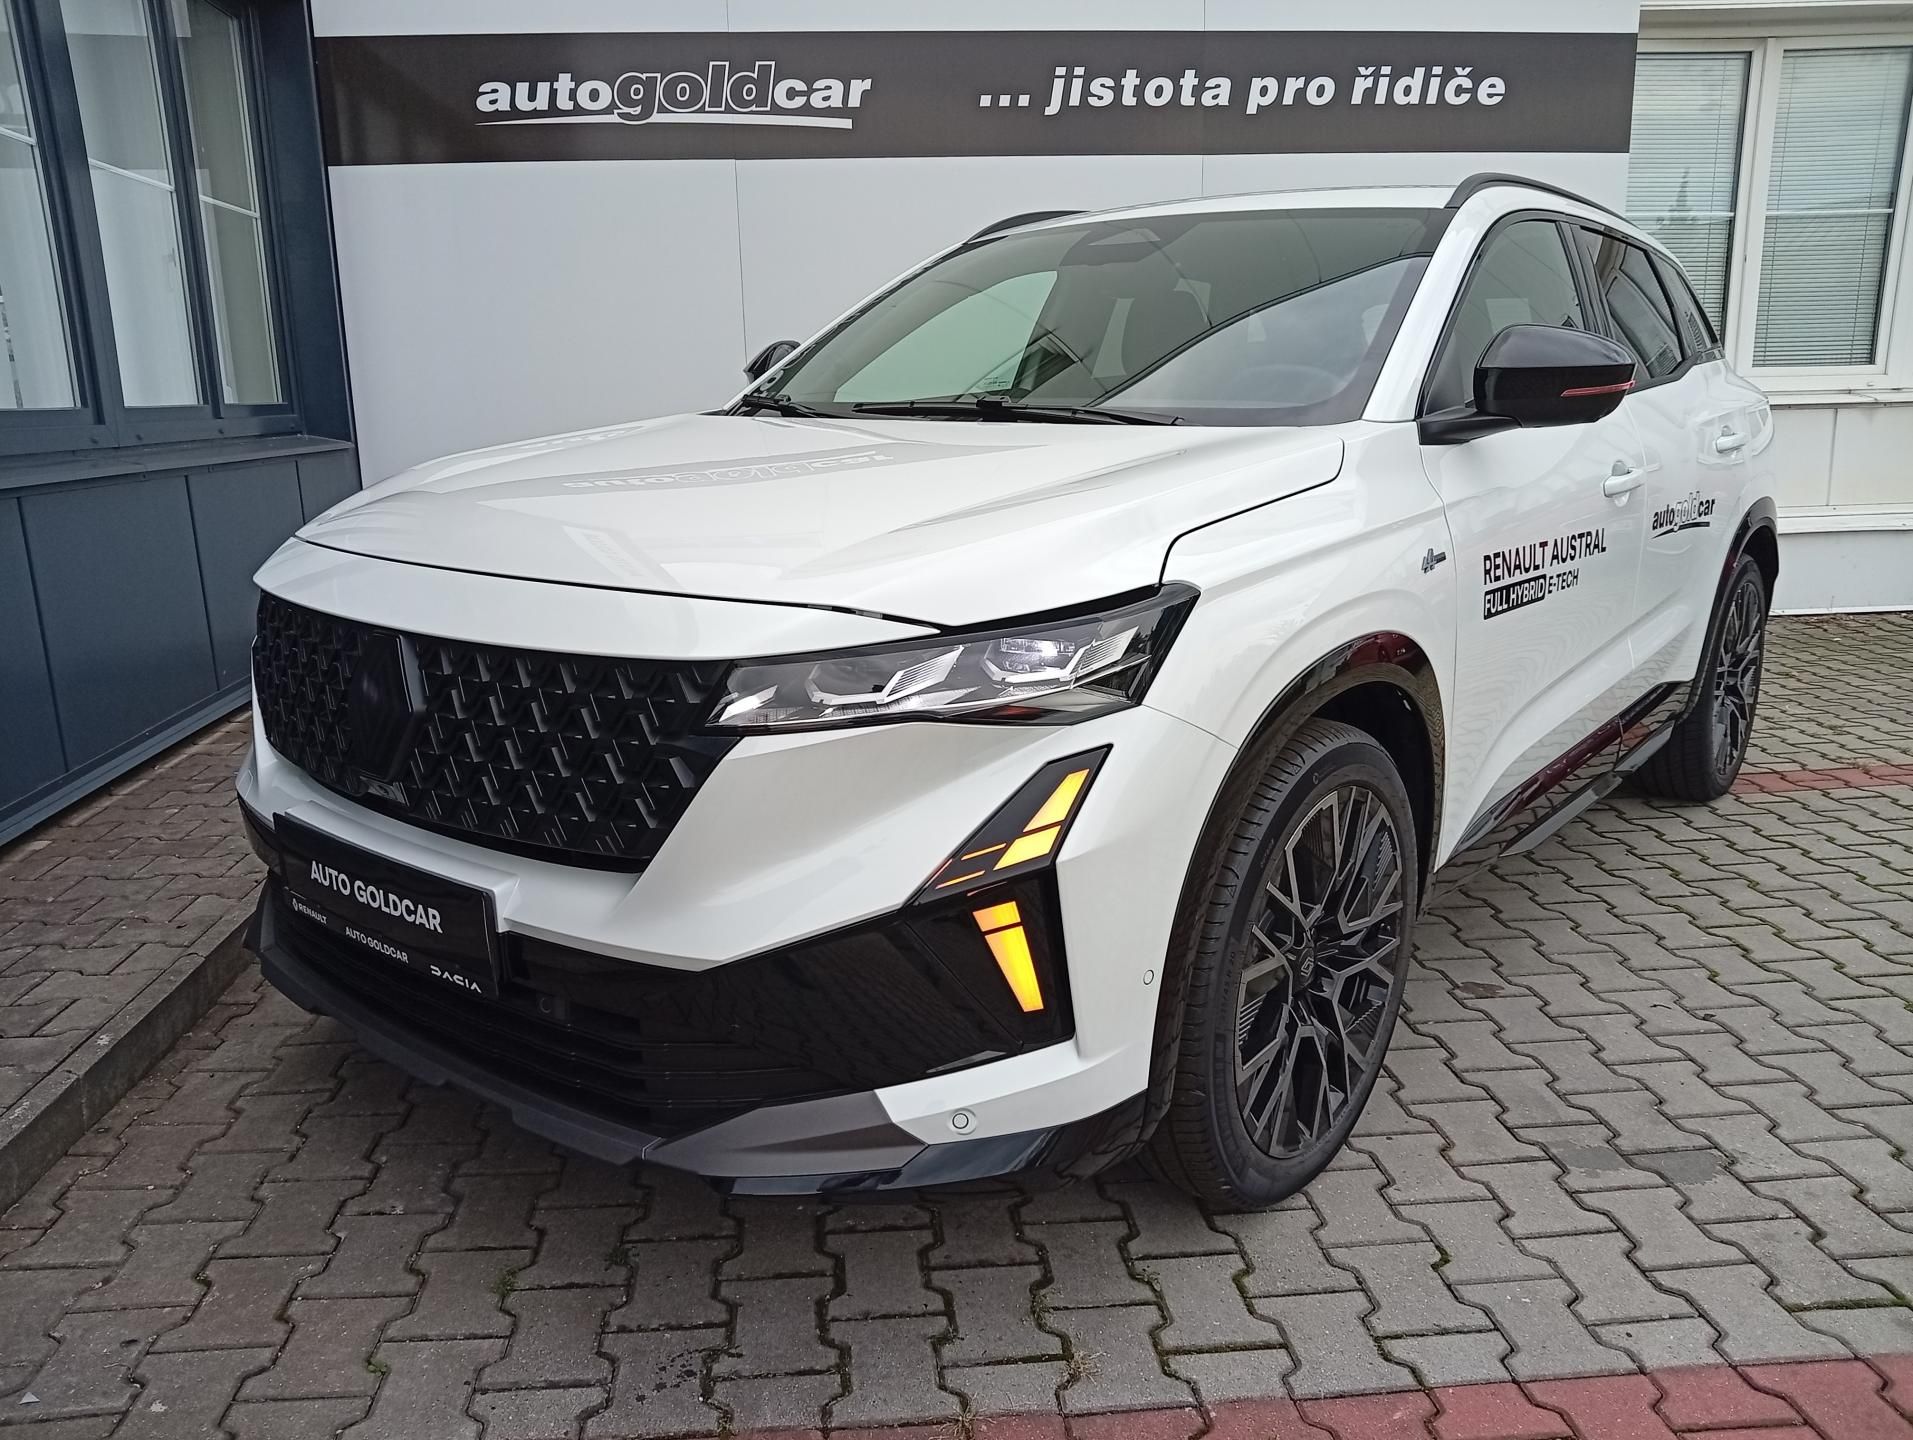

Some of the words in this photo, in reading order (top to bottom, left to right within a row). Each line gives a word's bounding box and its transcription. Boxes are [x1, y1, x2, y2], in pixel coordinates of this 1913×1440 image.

[475, 61, 873, 124] autogoldcar
[1045, 66, 1230, 115] jistota
[1246, 76, 1336, 115] pro
[1351, 66, 1507, 106] řidiče
[1651, 490, 1716, 533] autogoldcar
[1483, 540, 1548, 586] RENAULT
[1550, 527, 1607, 567] AUSTRAL
[1484, 589, 1509, 616] FULL
[1509, 578, 1546, 607] HYBRID
[1547, 567, 1580, 595] E-TECH
[298, 902, 328, 925] RENAULT
[310, 860, 351, 896] AUTO
[353, 880, 443, 934] GOLDCAR
[345, 926, 367, 944] AUTO
[367, 936, 409, 964] GOLDCAR
[429, 964, 483, 994] DACIA
